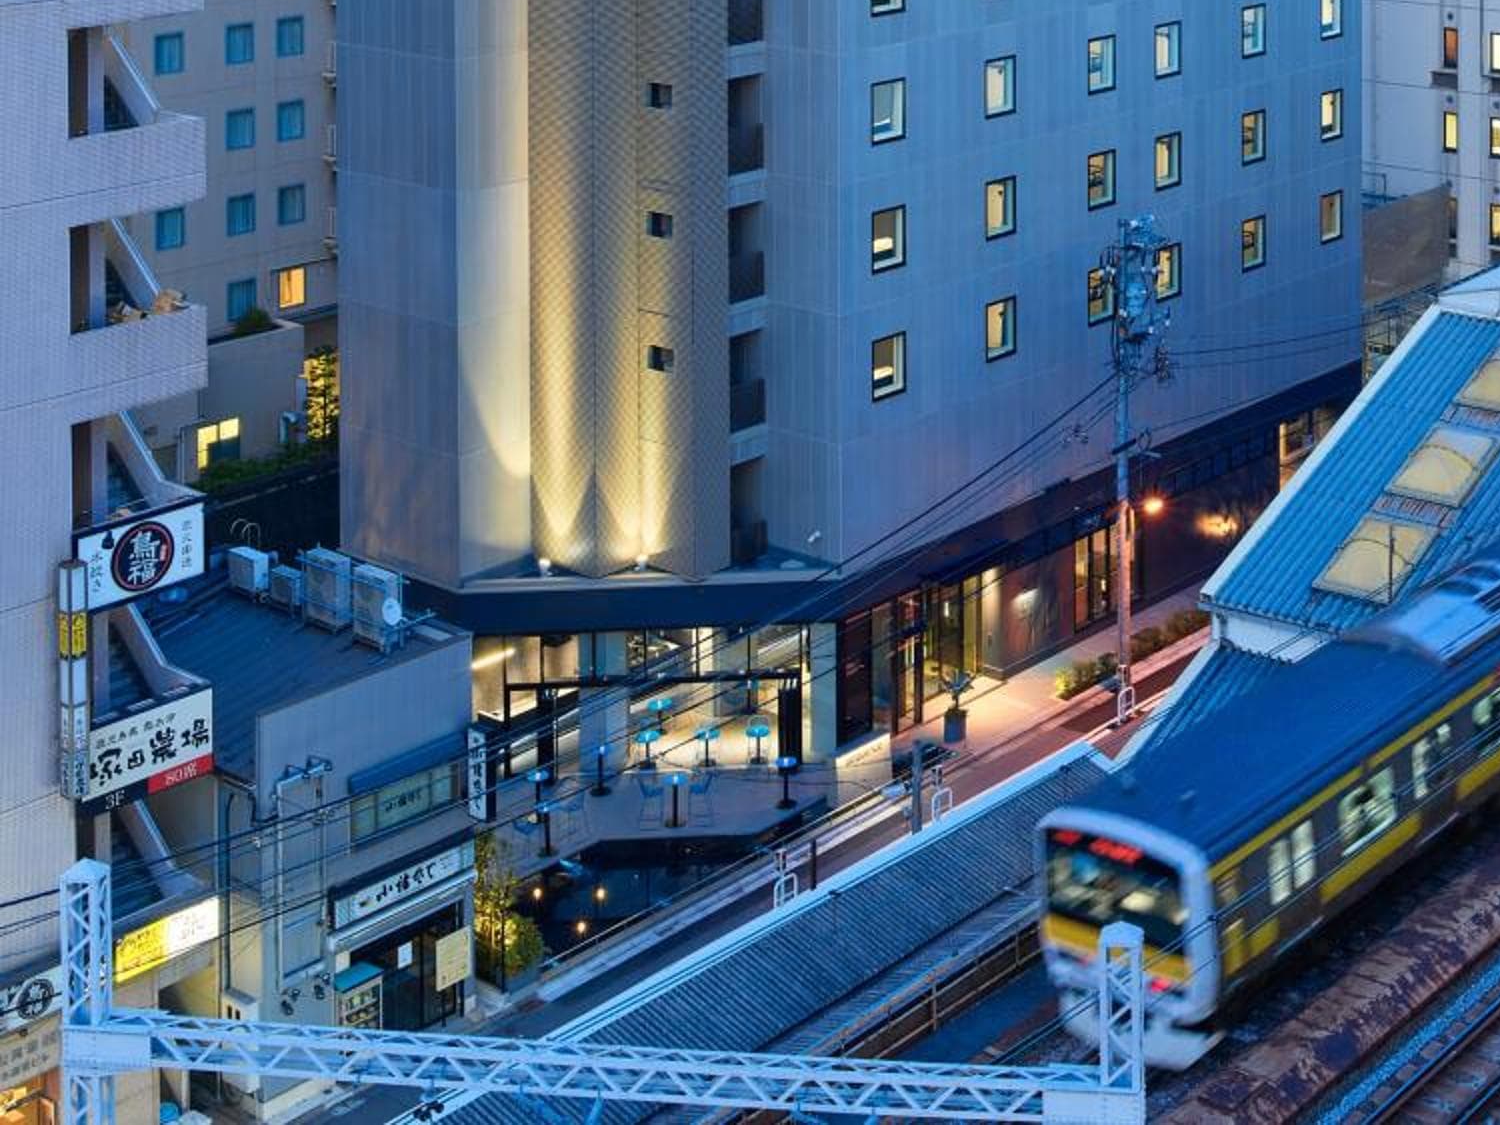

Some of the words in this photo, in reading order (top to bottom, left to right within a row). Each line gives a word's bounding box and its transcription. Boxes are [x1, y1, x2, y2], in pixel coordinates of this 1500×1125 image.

[127, 531, 161, 585] 鳥福
[89, 718, 209, 787] 塚田農場
[105, 790, 125, 810] 3F
